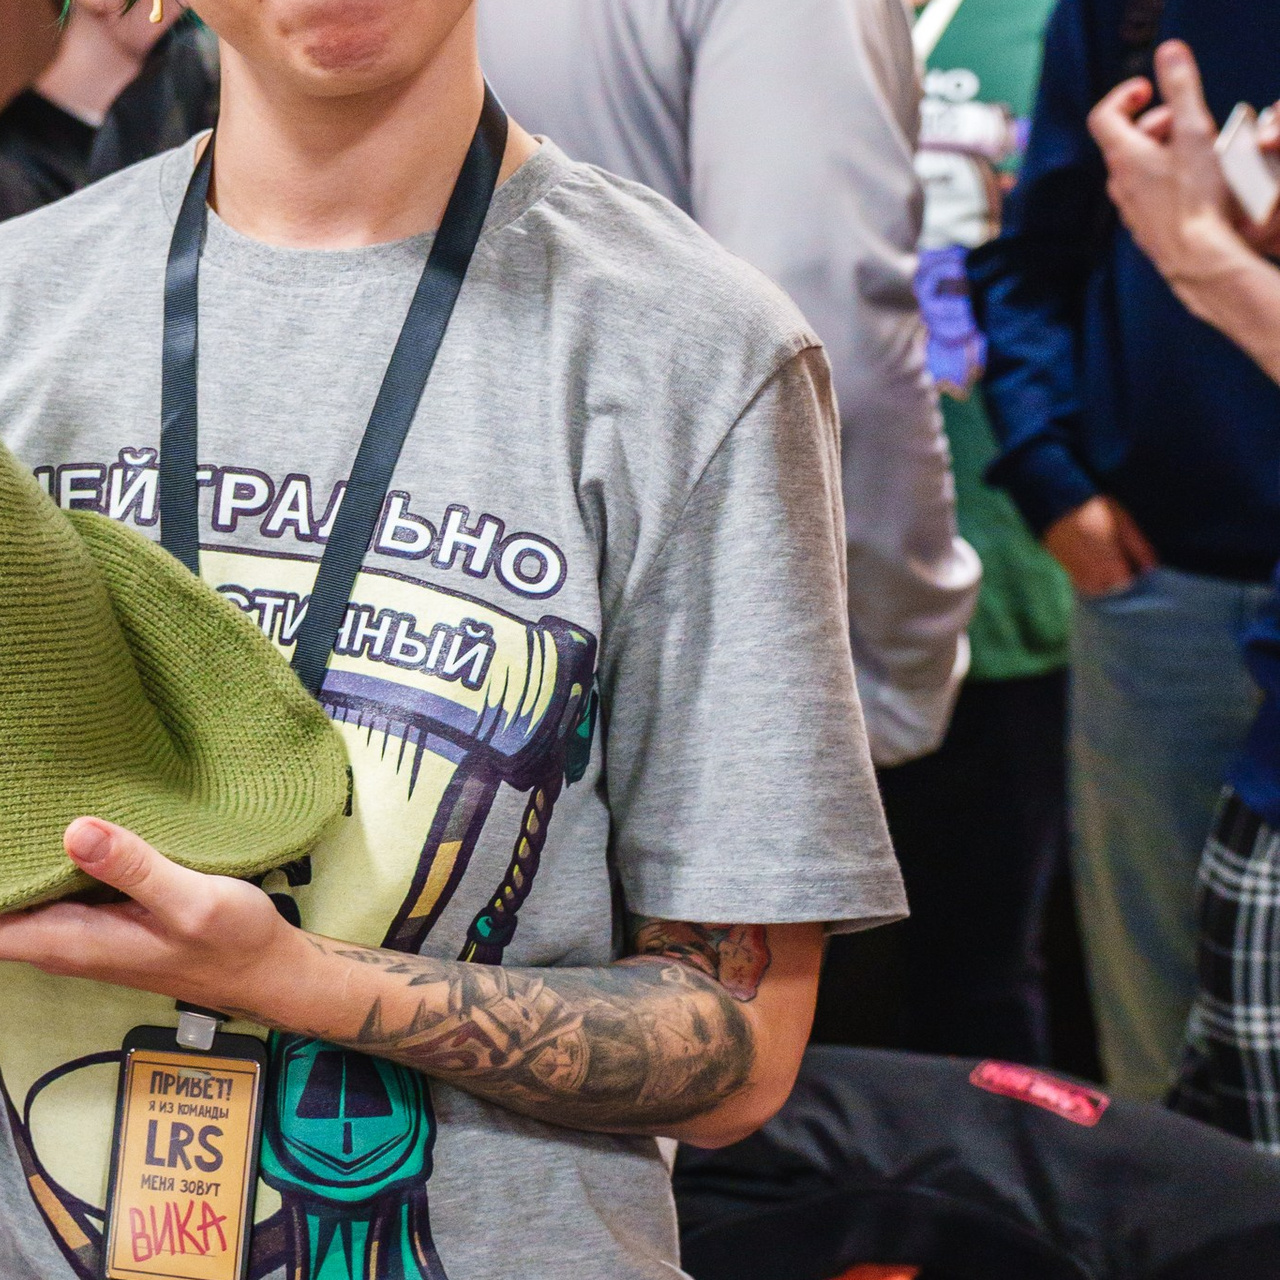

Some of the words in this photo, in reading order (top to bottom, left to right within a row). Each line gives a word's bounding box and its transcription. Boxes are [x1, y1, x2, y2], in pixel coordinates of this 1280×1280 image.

[33, 447, 567, 600] ЕЙРАЬНО
[149, 1070, 233, 1101] ПРИВЕТ!
[148, 1100, 155, 1112] Я
[159, 1101, 174, 1114] ИЗ
[178, 1102, 229, 1120] КОМАНДЫ
[145, 1119, 224, 1173] LRS
[141, 1173, 175, 1192] МЕНЯ
[180, 1179, 221, 1197] ЗОВУТ
[129, 1199, 227, 1263] ВИКА
